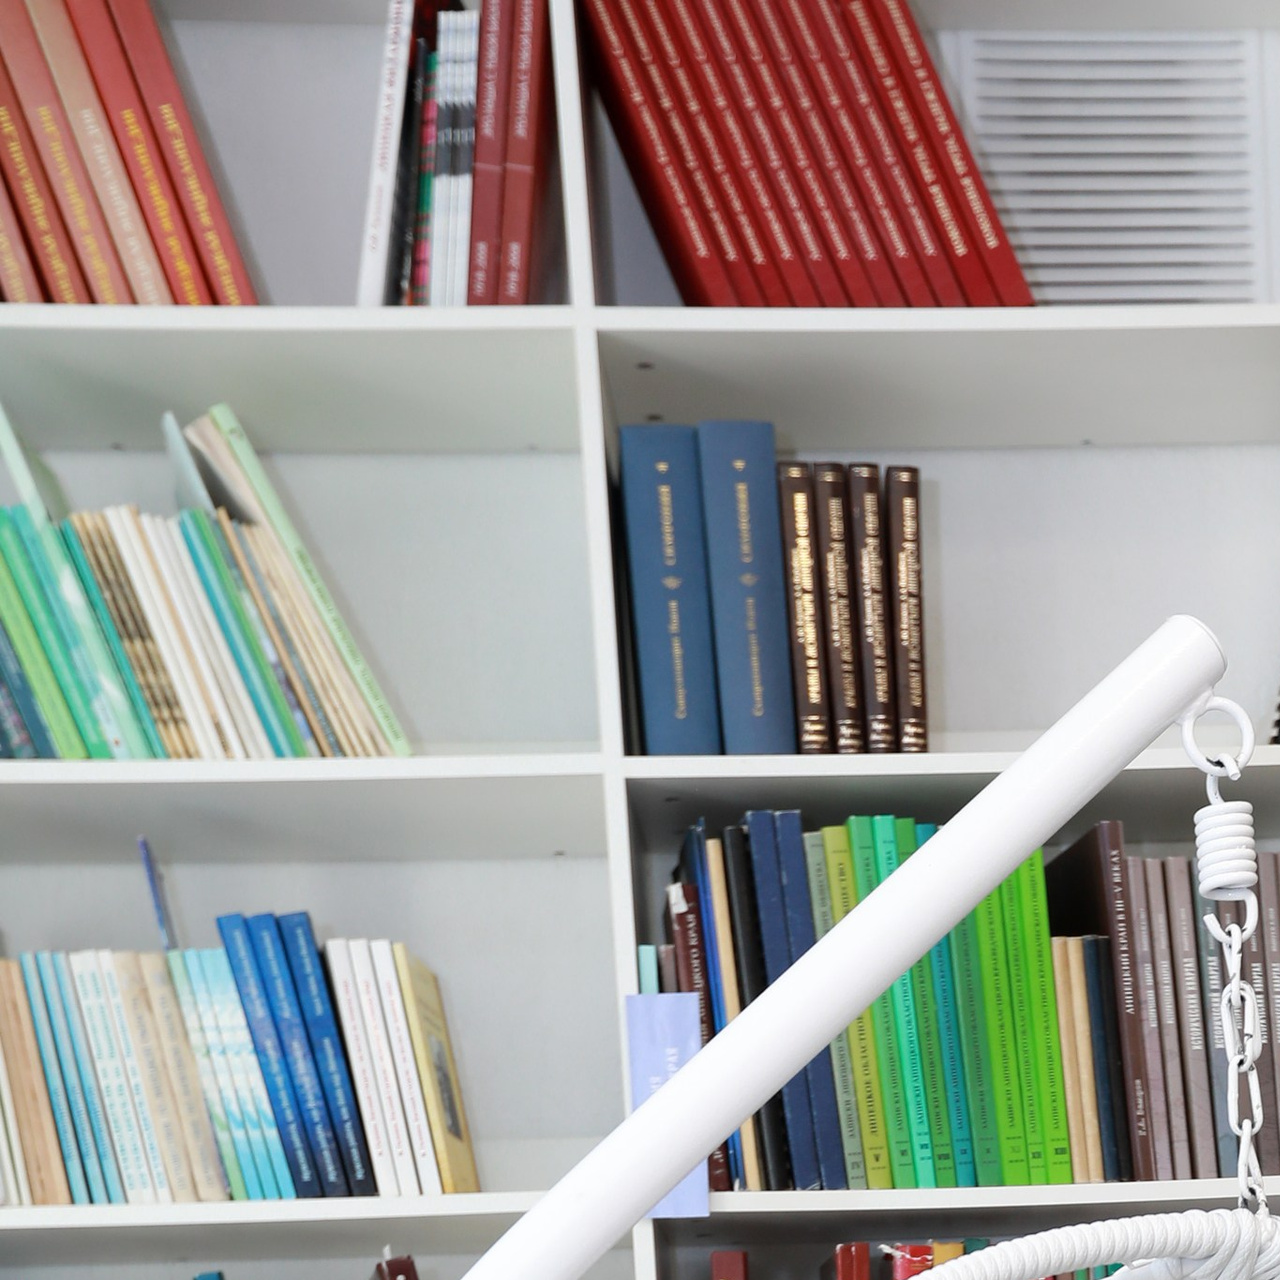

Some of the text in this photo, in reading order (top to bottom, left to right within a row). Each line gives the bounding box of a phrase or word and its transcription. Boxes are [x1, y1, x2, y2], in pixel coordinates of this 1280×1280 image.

[1110, 848, 1122, 879] ВЕКАХ
[1121, 952, 1137, 1015] ЛИПЕЦКИЙ
[1181, 958, 1198, 990] КВАРТАЛ
